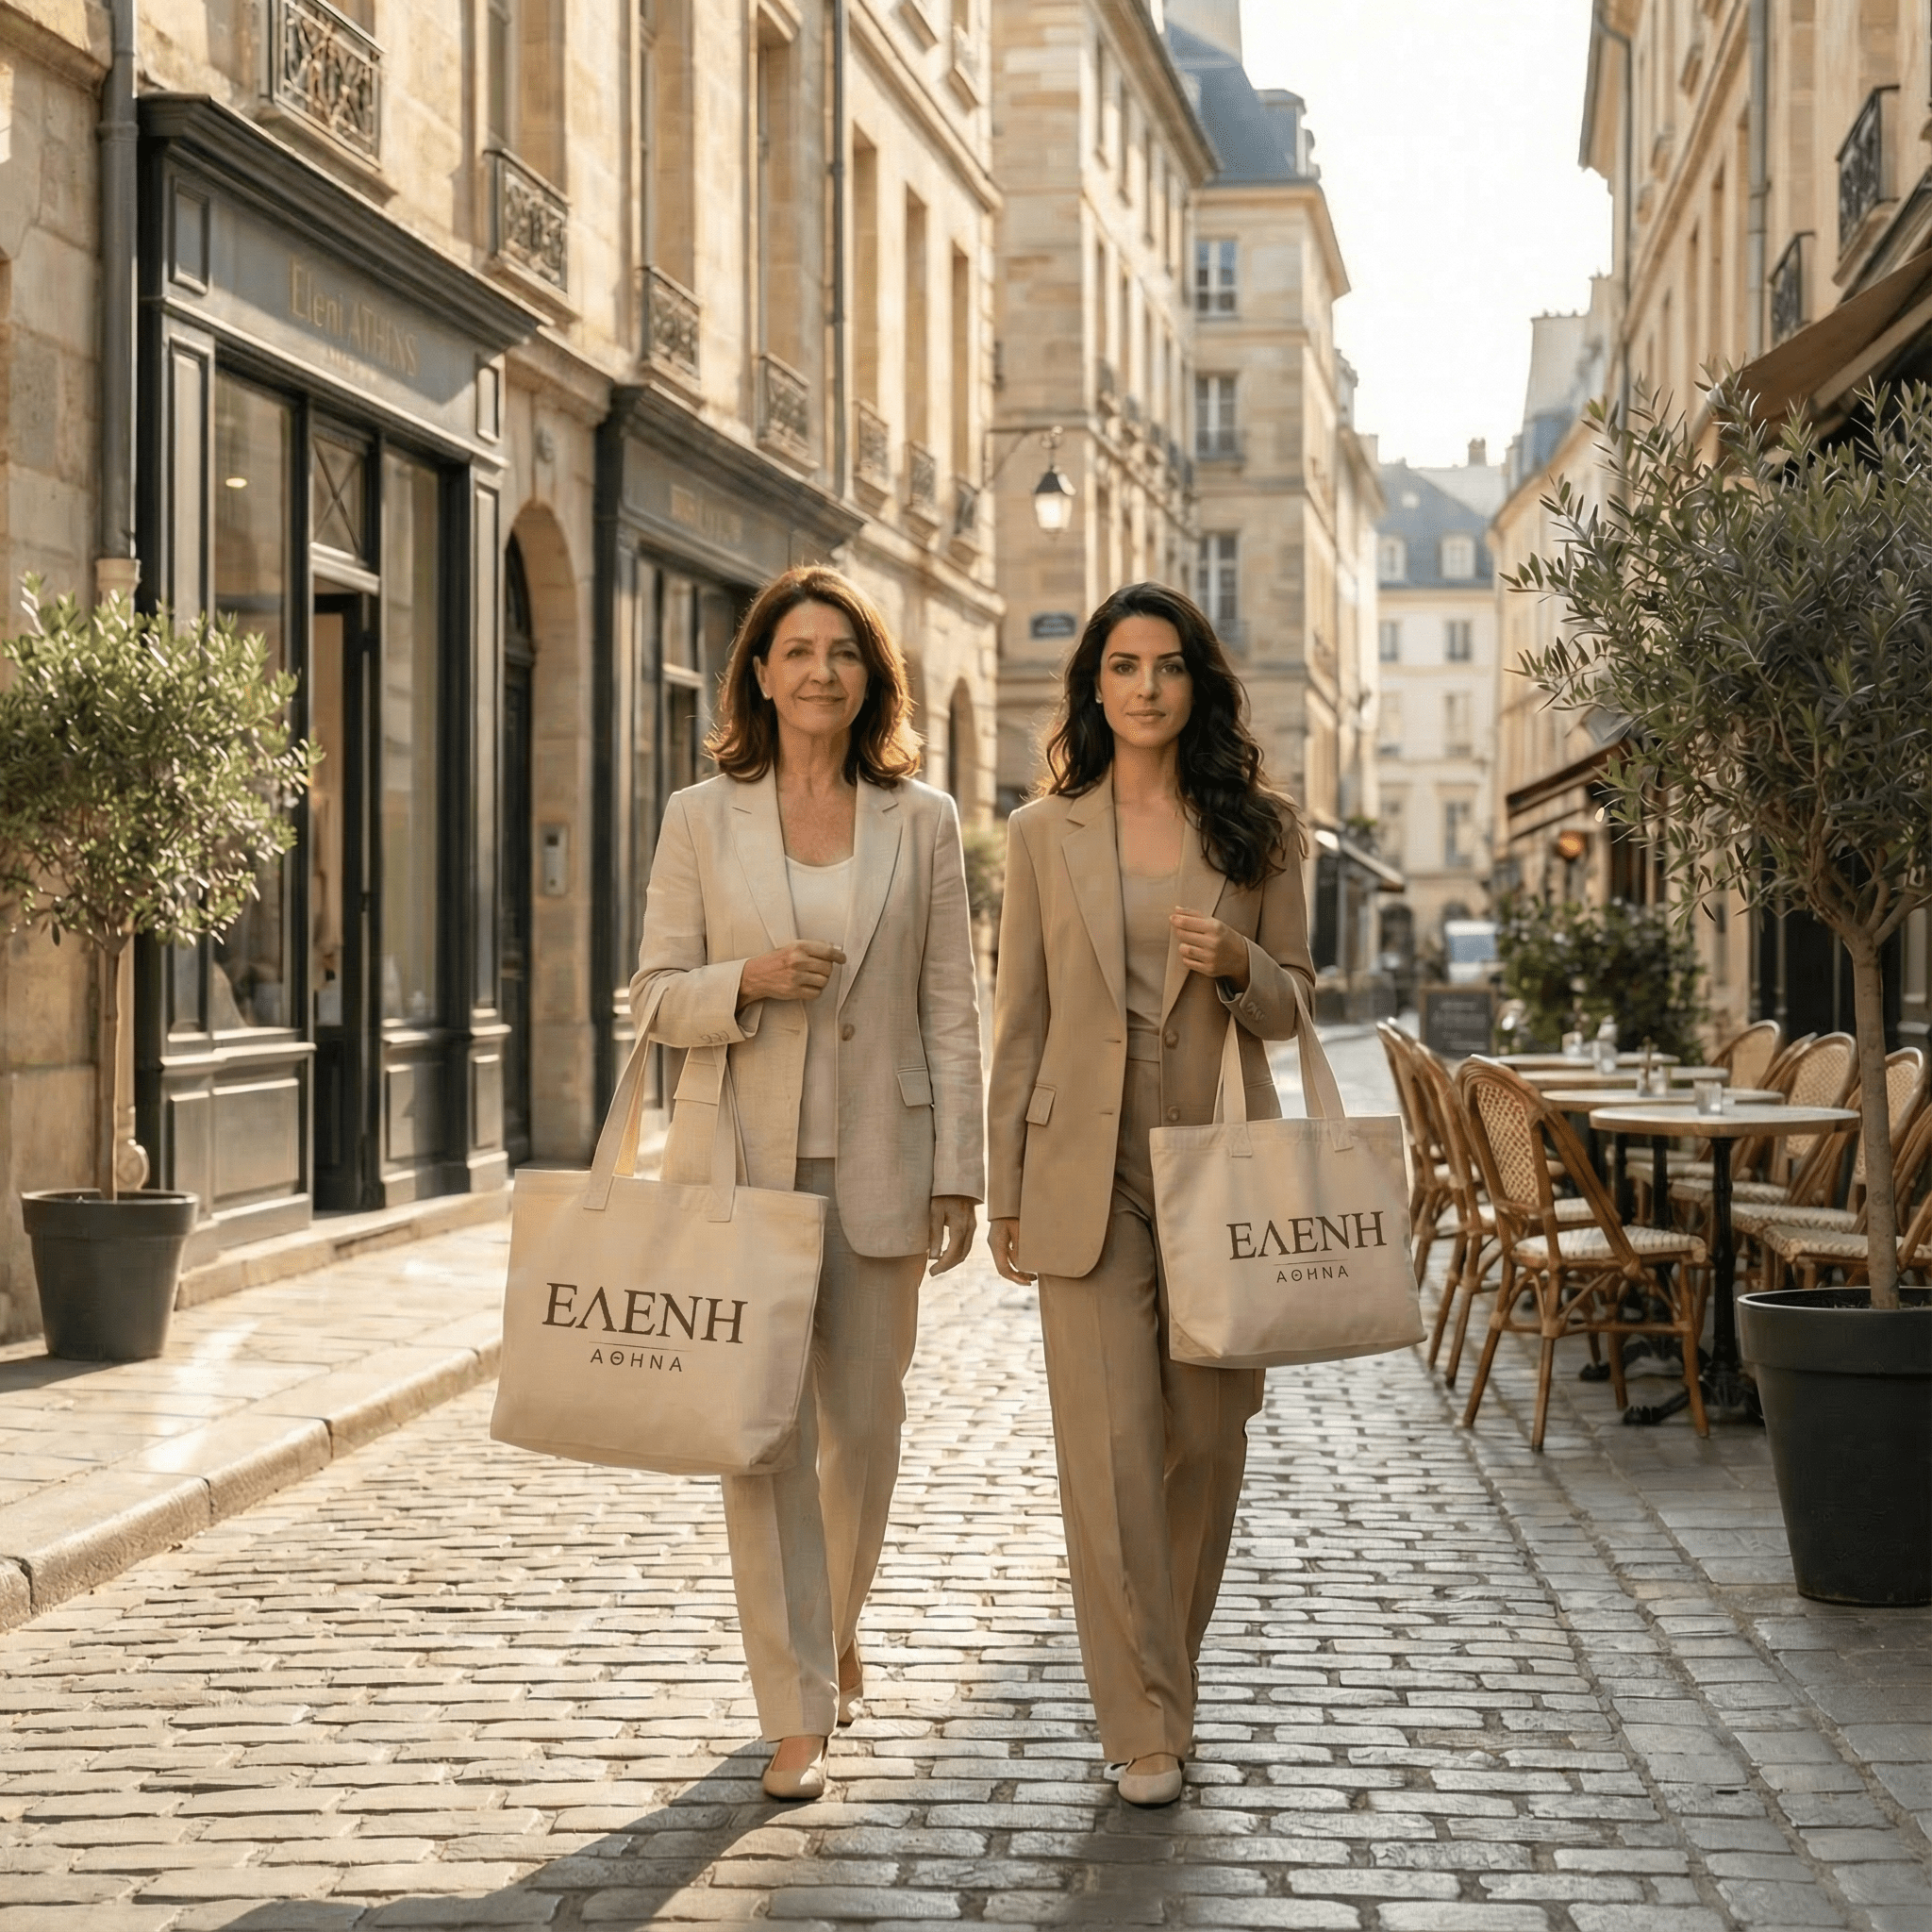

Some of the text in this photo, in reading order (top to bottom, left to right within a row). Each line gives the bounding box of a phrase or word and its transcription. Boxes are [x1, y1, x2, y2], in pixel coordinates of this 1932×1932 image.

[1225, 1210, 1388, 1261] ΕΛΕΝΗ
[1276, 1264, 1349, 1284] ΑΘΗΝΑ
[541, 1282, 749, 1344] ΕΛΕΝΗ
[590, 1348, 683, 1373] ΑΘΗΝΑ
